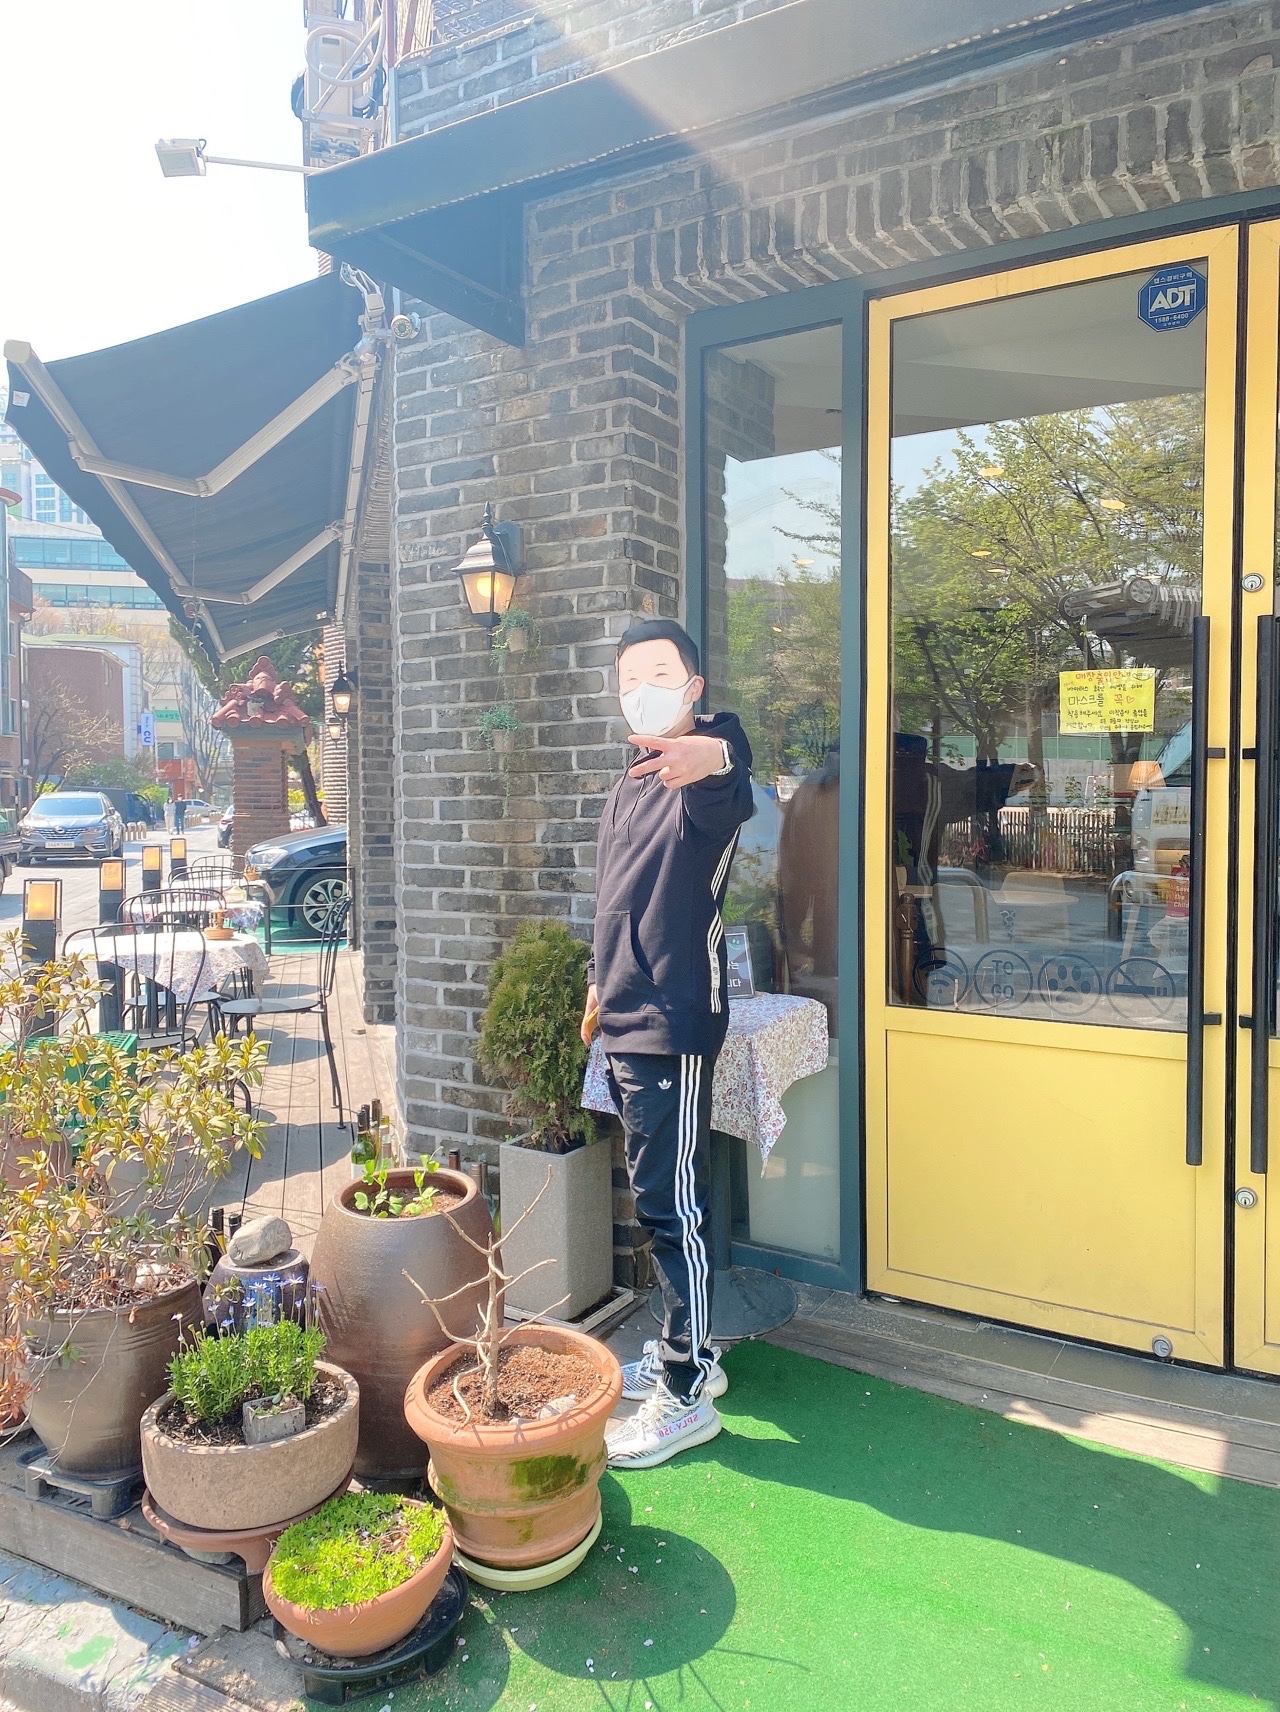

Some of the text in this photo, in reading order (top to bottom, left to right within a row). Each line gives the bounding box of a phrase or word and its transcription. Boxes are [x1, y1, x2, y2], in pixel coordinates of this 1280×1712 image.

[1149, 284, 1196, 312] ADT
[1155, 312, 1189, 324] 1588-6400
[1068, 693, 1124, 707] 마스크를 꼭
[143, 730, 152, 744] CU
[992, 959, 1014, 976] TO
[991, 983, 1015, 1000] GO
